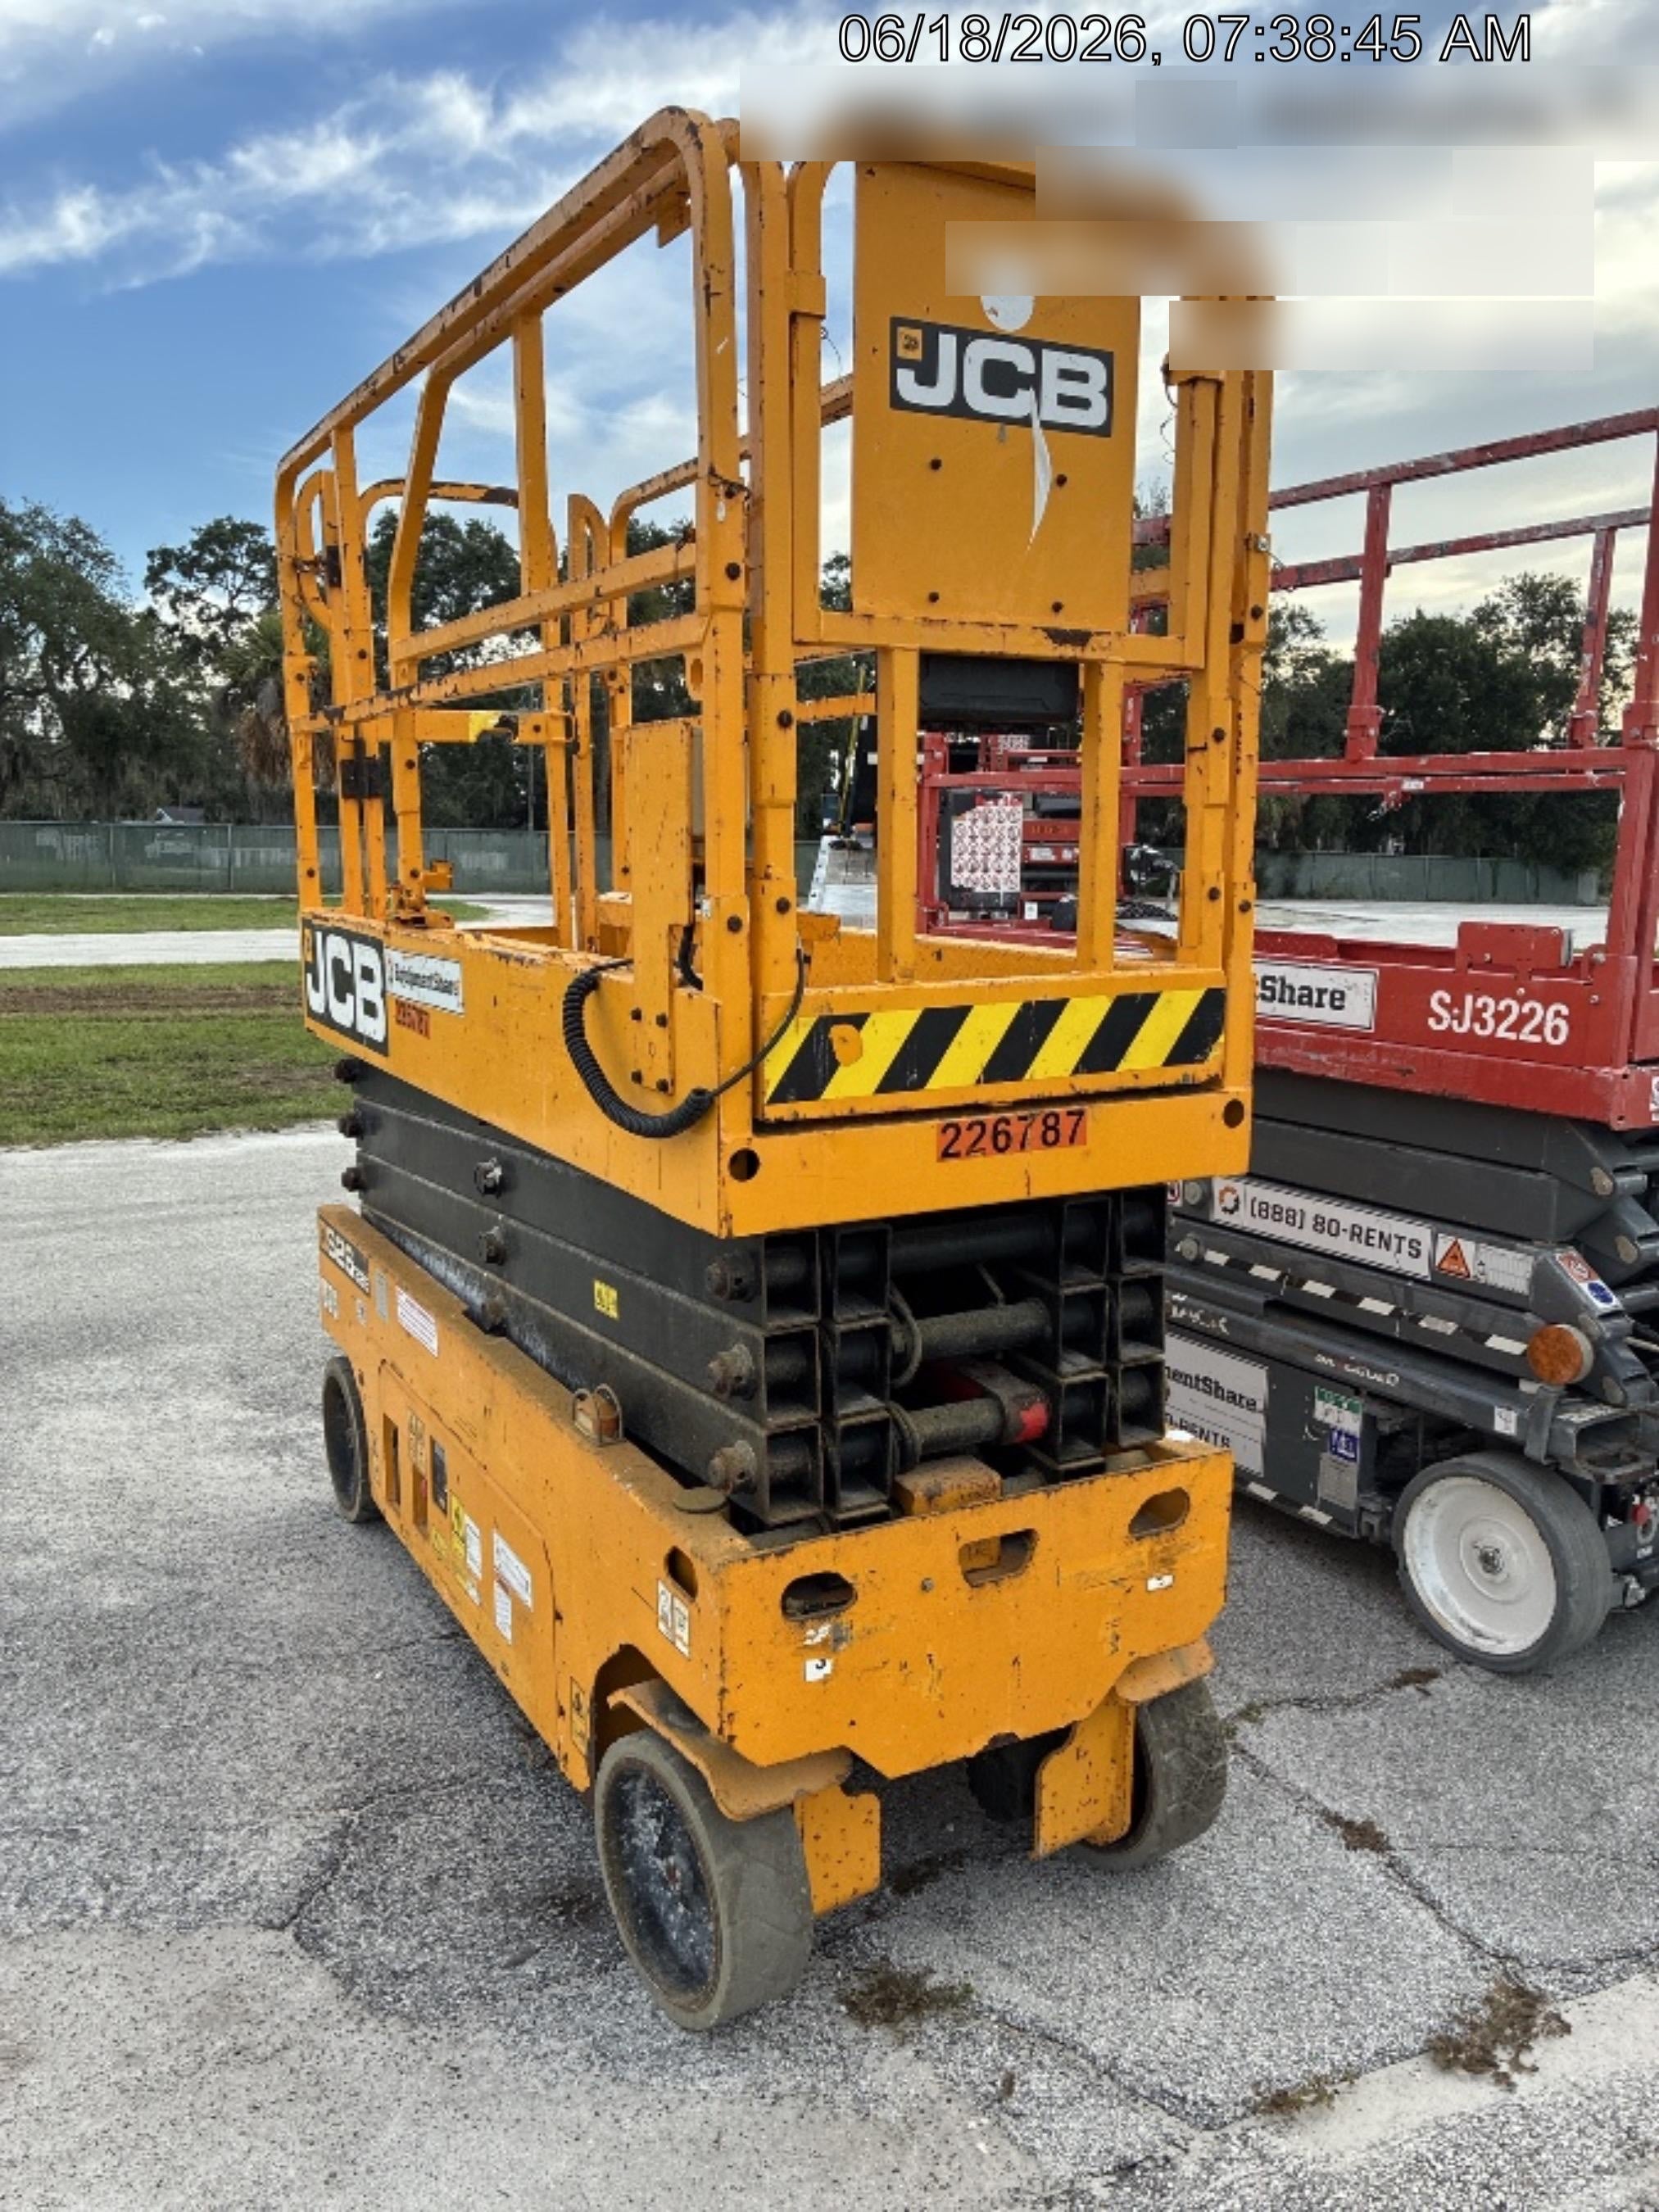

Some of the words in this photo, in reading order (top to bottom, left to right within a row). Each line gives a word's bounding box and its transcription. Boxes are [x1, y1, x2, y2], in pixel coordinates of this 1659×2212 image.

[896, 333, 1107, 428] JCB
[306, 930, 386, 1043] JCB
[1254, 975, 1346, 1011] Share
[1428, 989, 1570, 1046] SJ3226
[941, 1108, 1086, 1159] 226787
[1250, 1196, 1306, 1230] (888)
[1312, 1213, 1422, 1259] 80-RENTS
